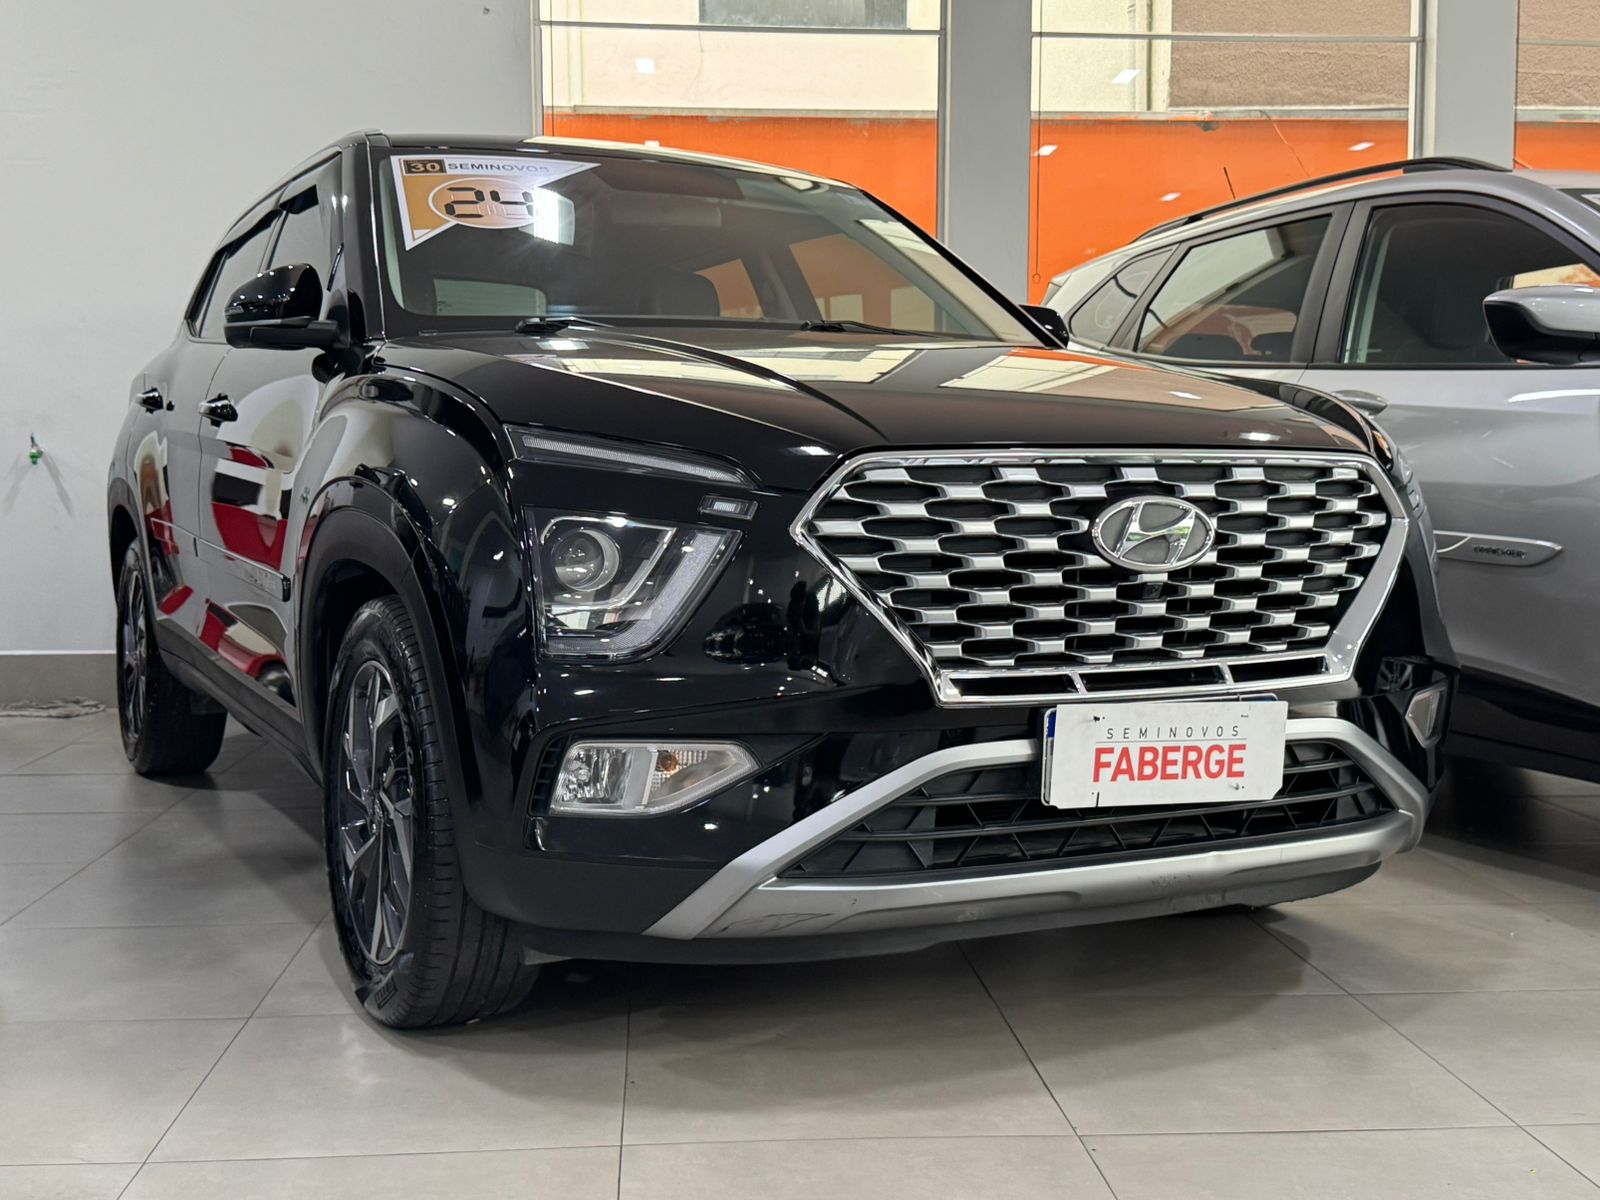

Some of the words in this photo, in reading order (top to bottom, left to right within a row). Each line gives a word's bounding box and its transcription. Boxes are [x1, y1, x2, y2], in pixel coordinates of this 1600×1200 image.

[411, 161, 440, 173] 30
[447, 162, 550, 173] SEMINOVOS
[1106, 725, 1240, 740] SEMINOVOS
[1092, 743, 1247, 783] FABERGE
